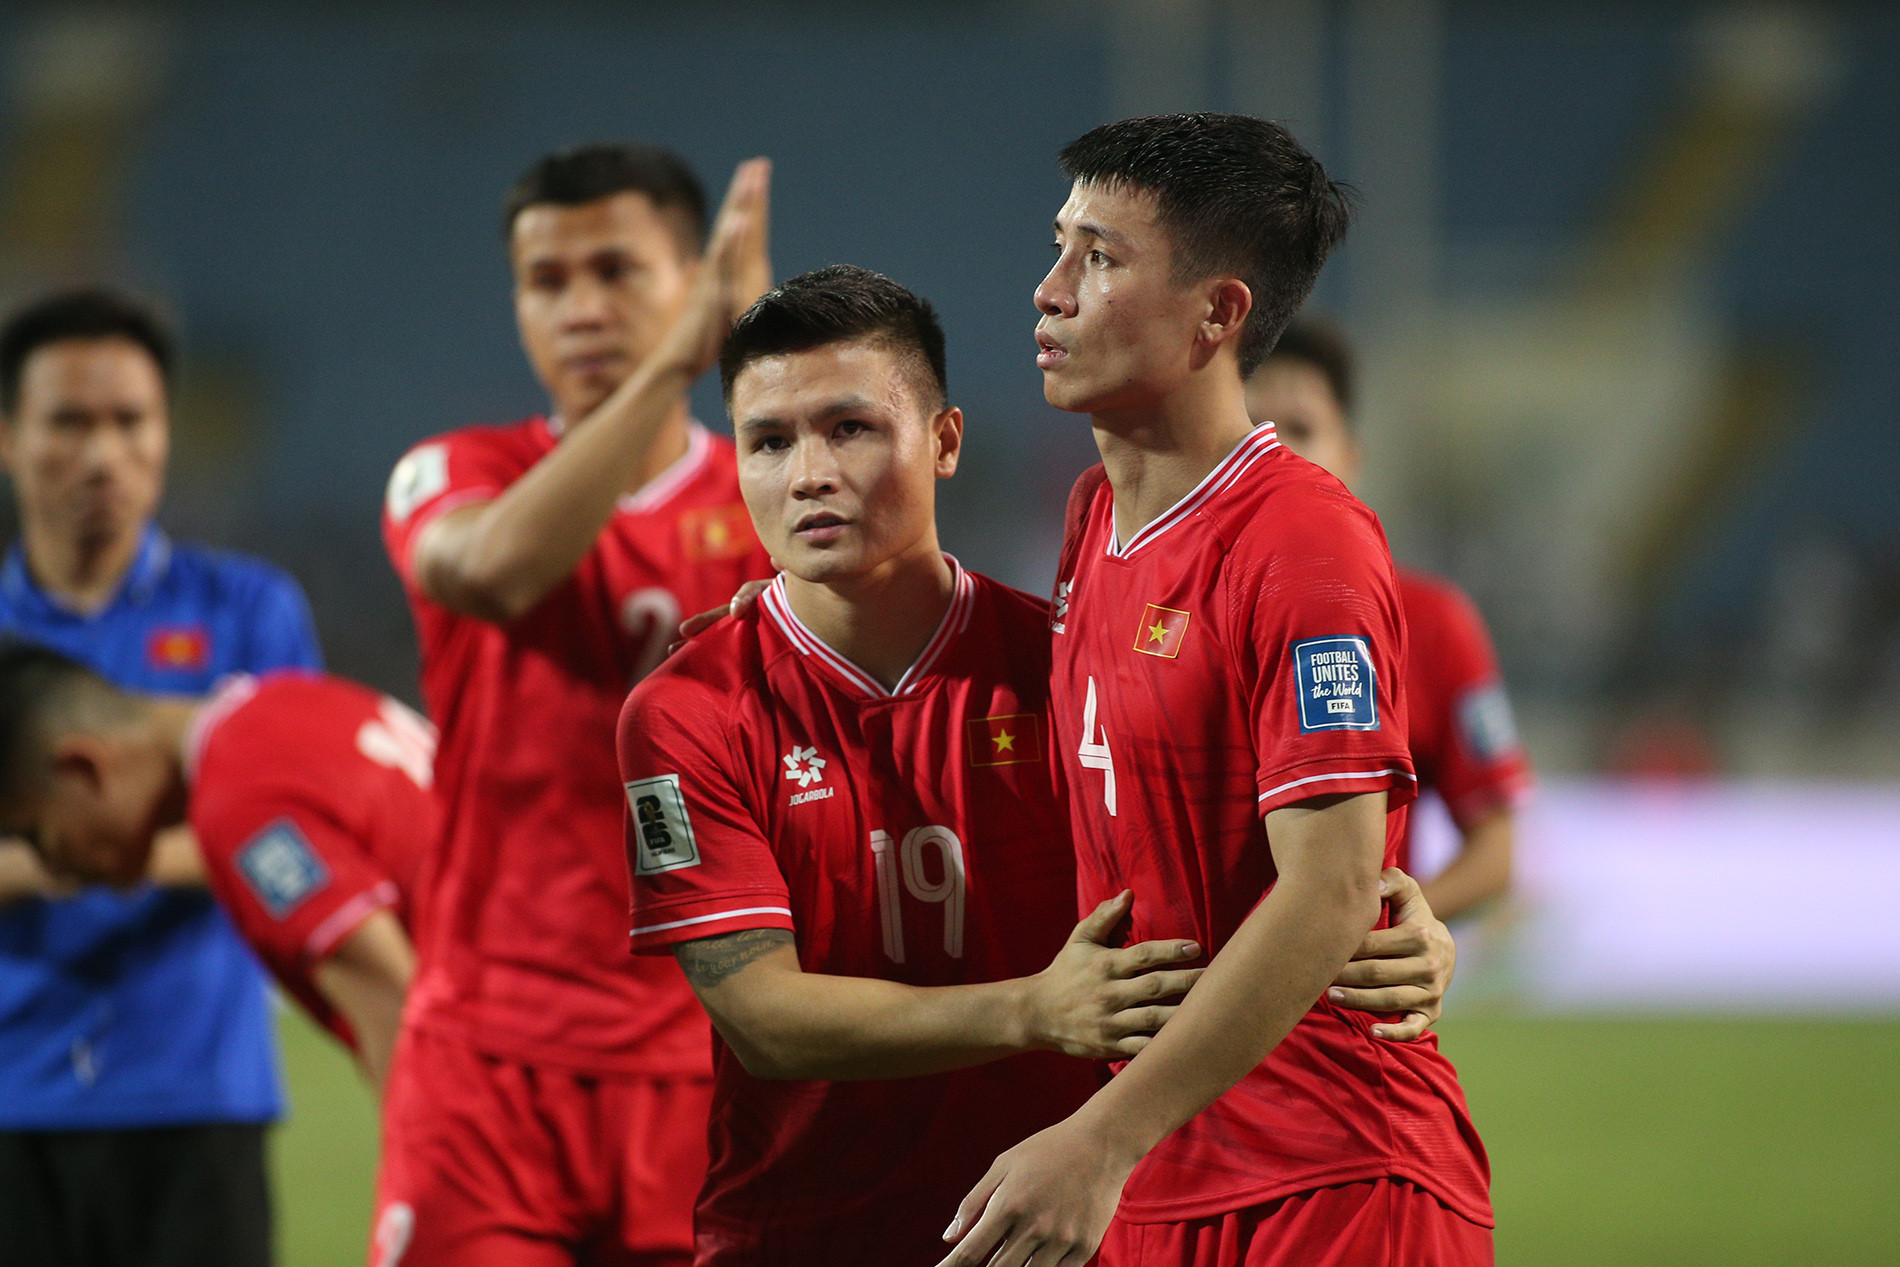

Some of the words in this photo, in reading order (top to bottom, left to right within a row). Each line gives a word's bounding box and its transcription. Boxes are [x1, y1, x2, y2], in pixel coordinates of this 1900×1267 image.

[1311, 651, 1358, 666] FOOTBALL
[1312, 664, 1359, 683] UNITES
[1311, 683, 1331, 699] the
[1332, 682, 1362, 698] World
[1331, 701, 1351, 711] FIFA
[1078, 675, 1117, 816] 4
[870, 825, 966, 964] 19
